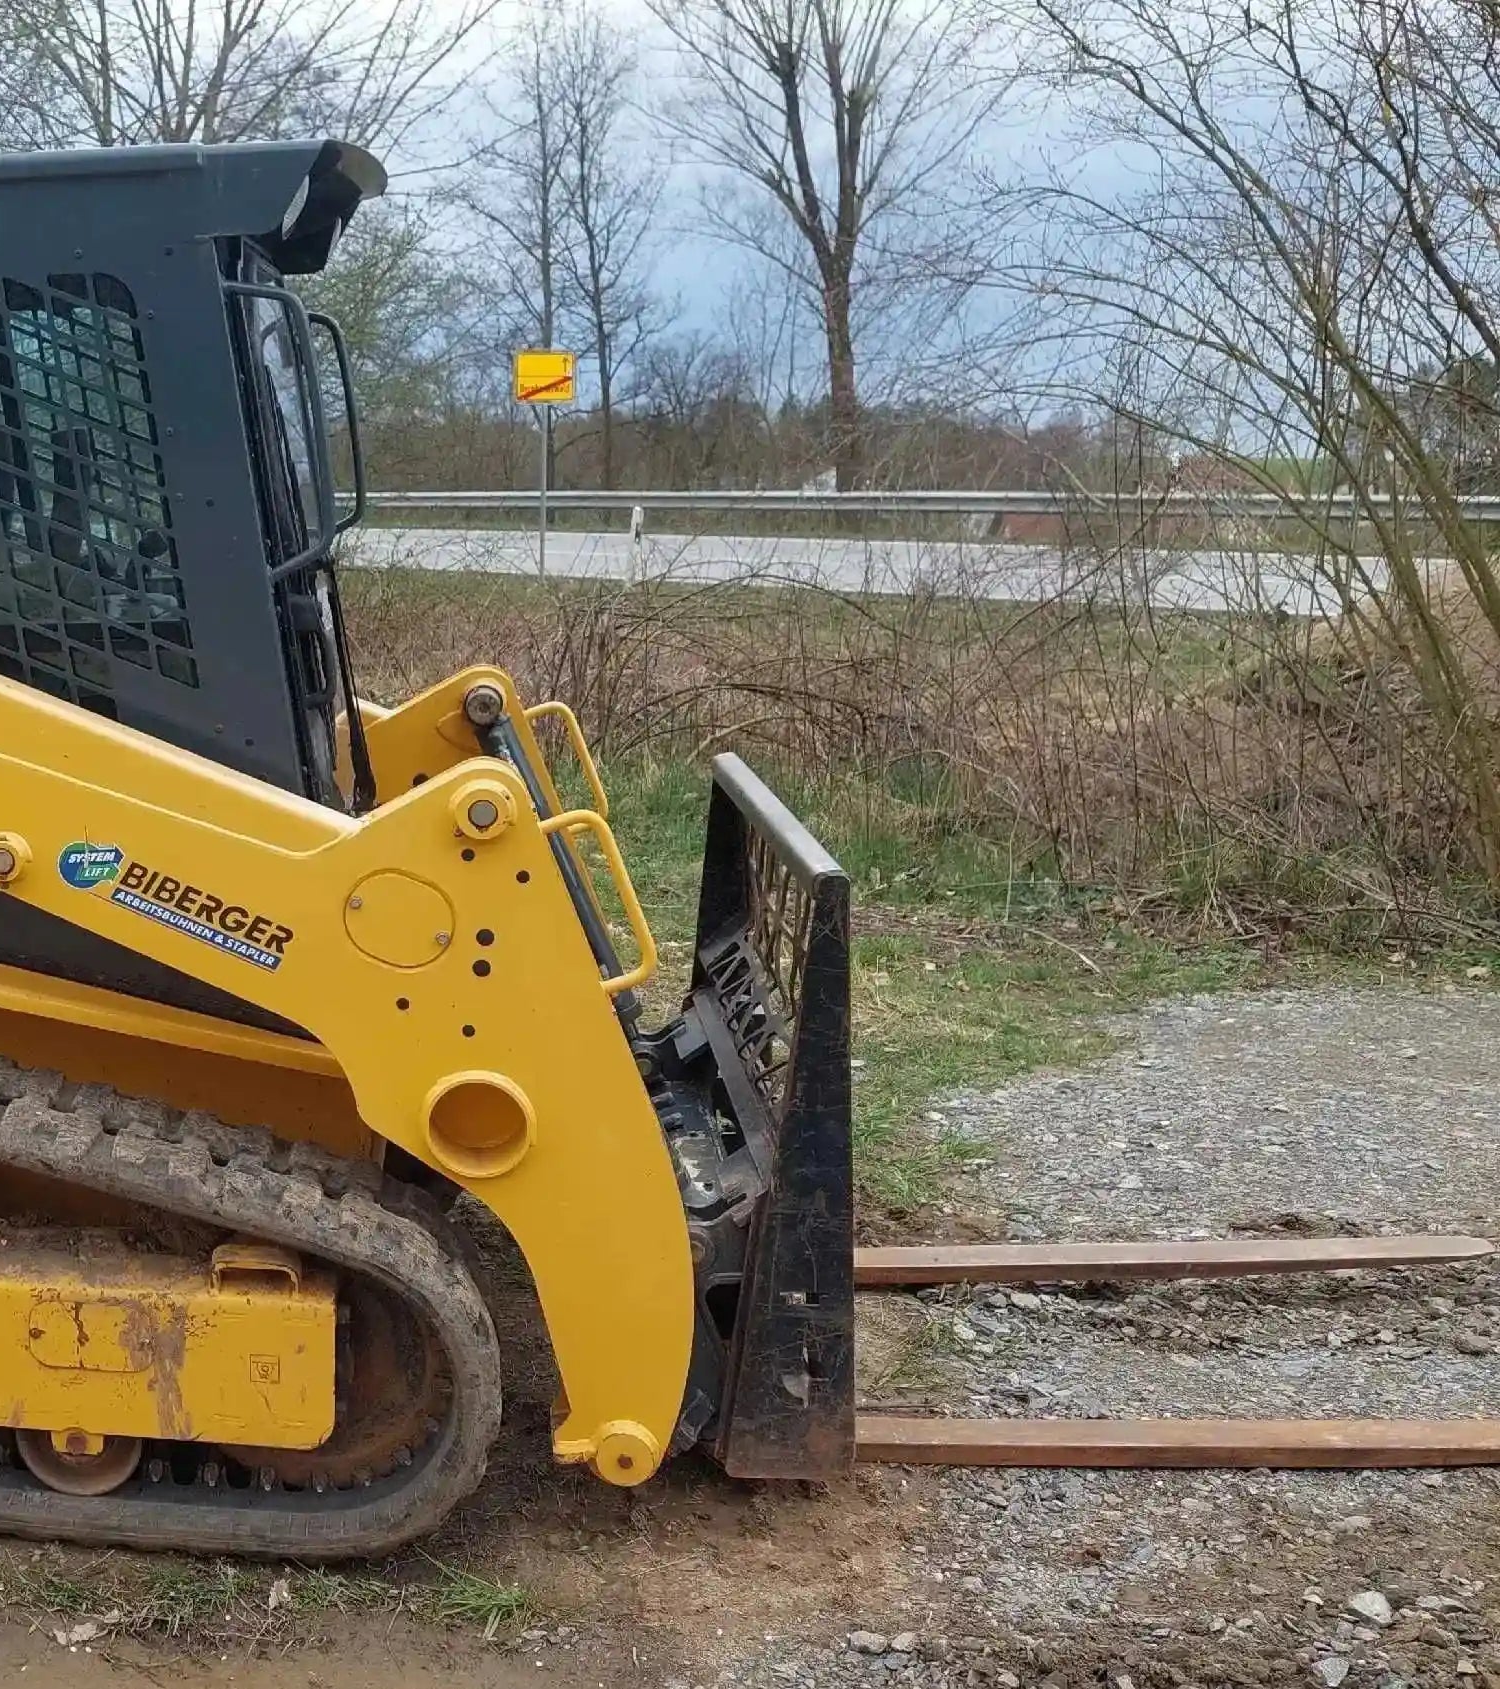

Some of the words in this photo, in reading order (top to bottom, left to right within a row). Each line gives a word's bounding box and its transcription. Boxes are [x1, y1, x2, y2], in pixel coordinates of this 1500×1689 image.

[68, 852, 115, 864] SYSTEM
[84, 867, 110, 877] LIFT
[119, 862, 294, 954] BIBERGER
[215, 935, 224, 944] &
[225, 939, 276, 966] STAPLER
